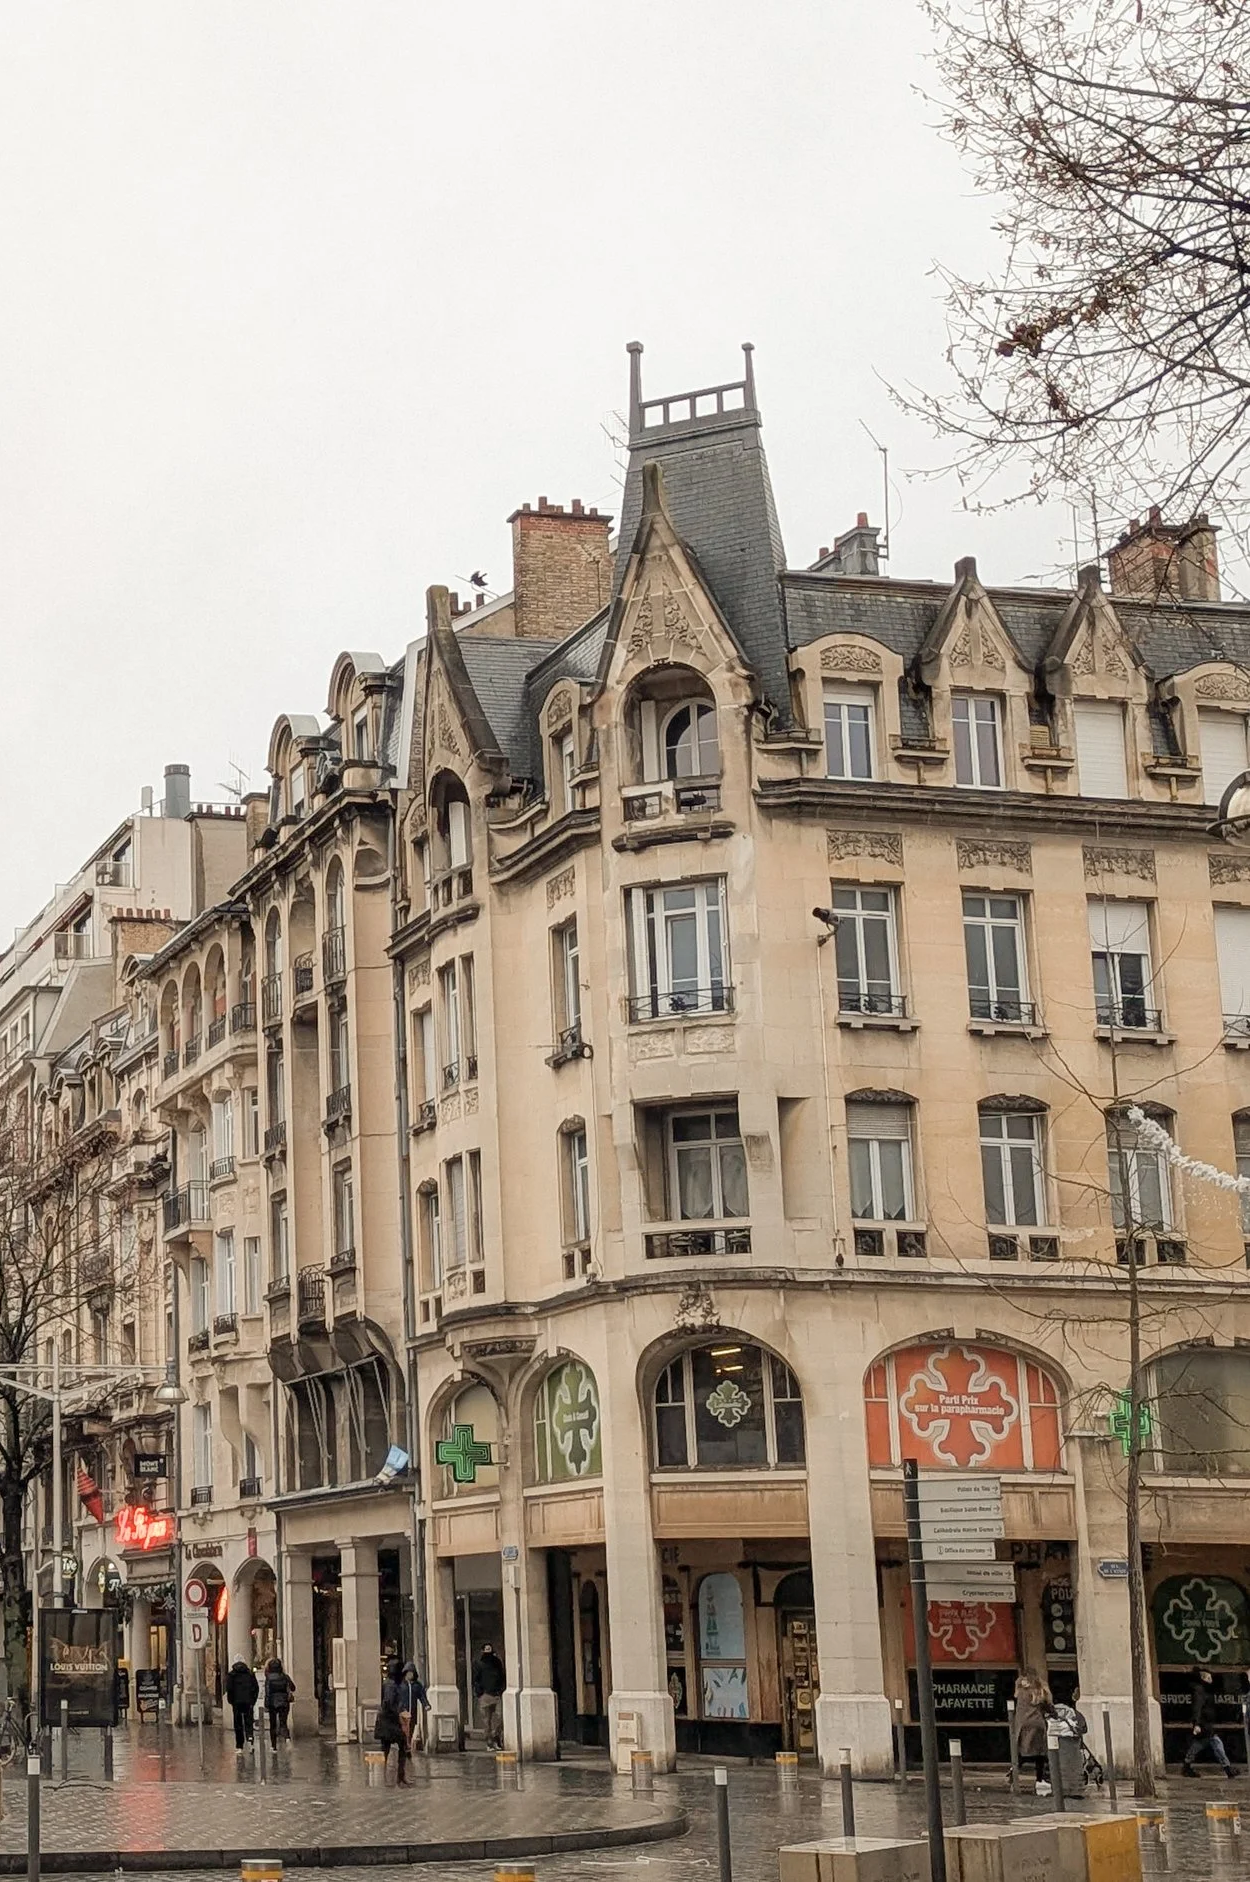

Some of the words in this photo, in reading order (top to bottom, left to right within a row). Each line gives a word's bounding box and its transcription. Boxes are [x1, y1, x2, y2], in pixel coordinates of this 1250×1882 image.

[939, 1394, 959, 1404] Parti
[961, 1394, 978, 1404] Prix
[915, 1404, 929, 1412] sur
[931, 1403, 939, 1412] la
[941, 1404, 1005, 1415] parapharmacie
[192, 1624, 202, 1642] D
[50, 1663, 73, 1671] LOUIS
[74, 1663, 108, 1671] VUITTON
[932, 1683, 995, 1694] PHARMACIE
[934, 1698, 994, 1708] LAFAYETTE
